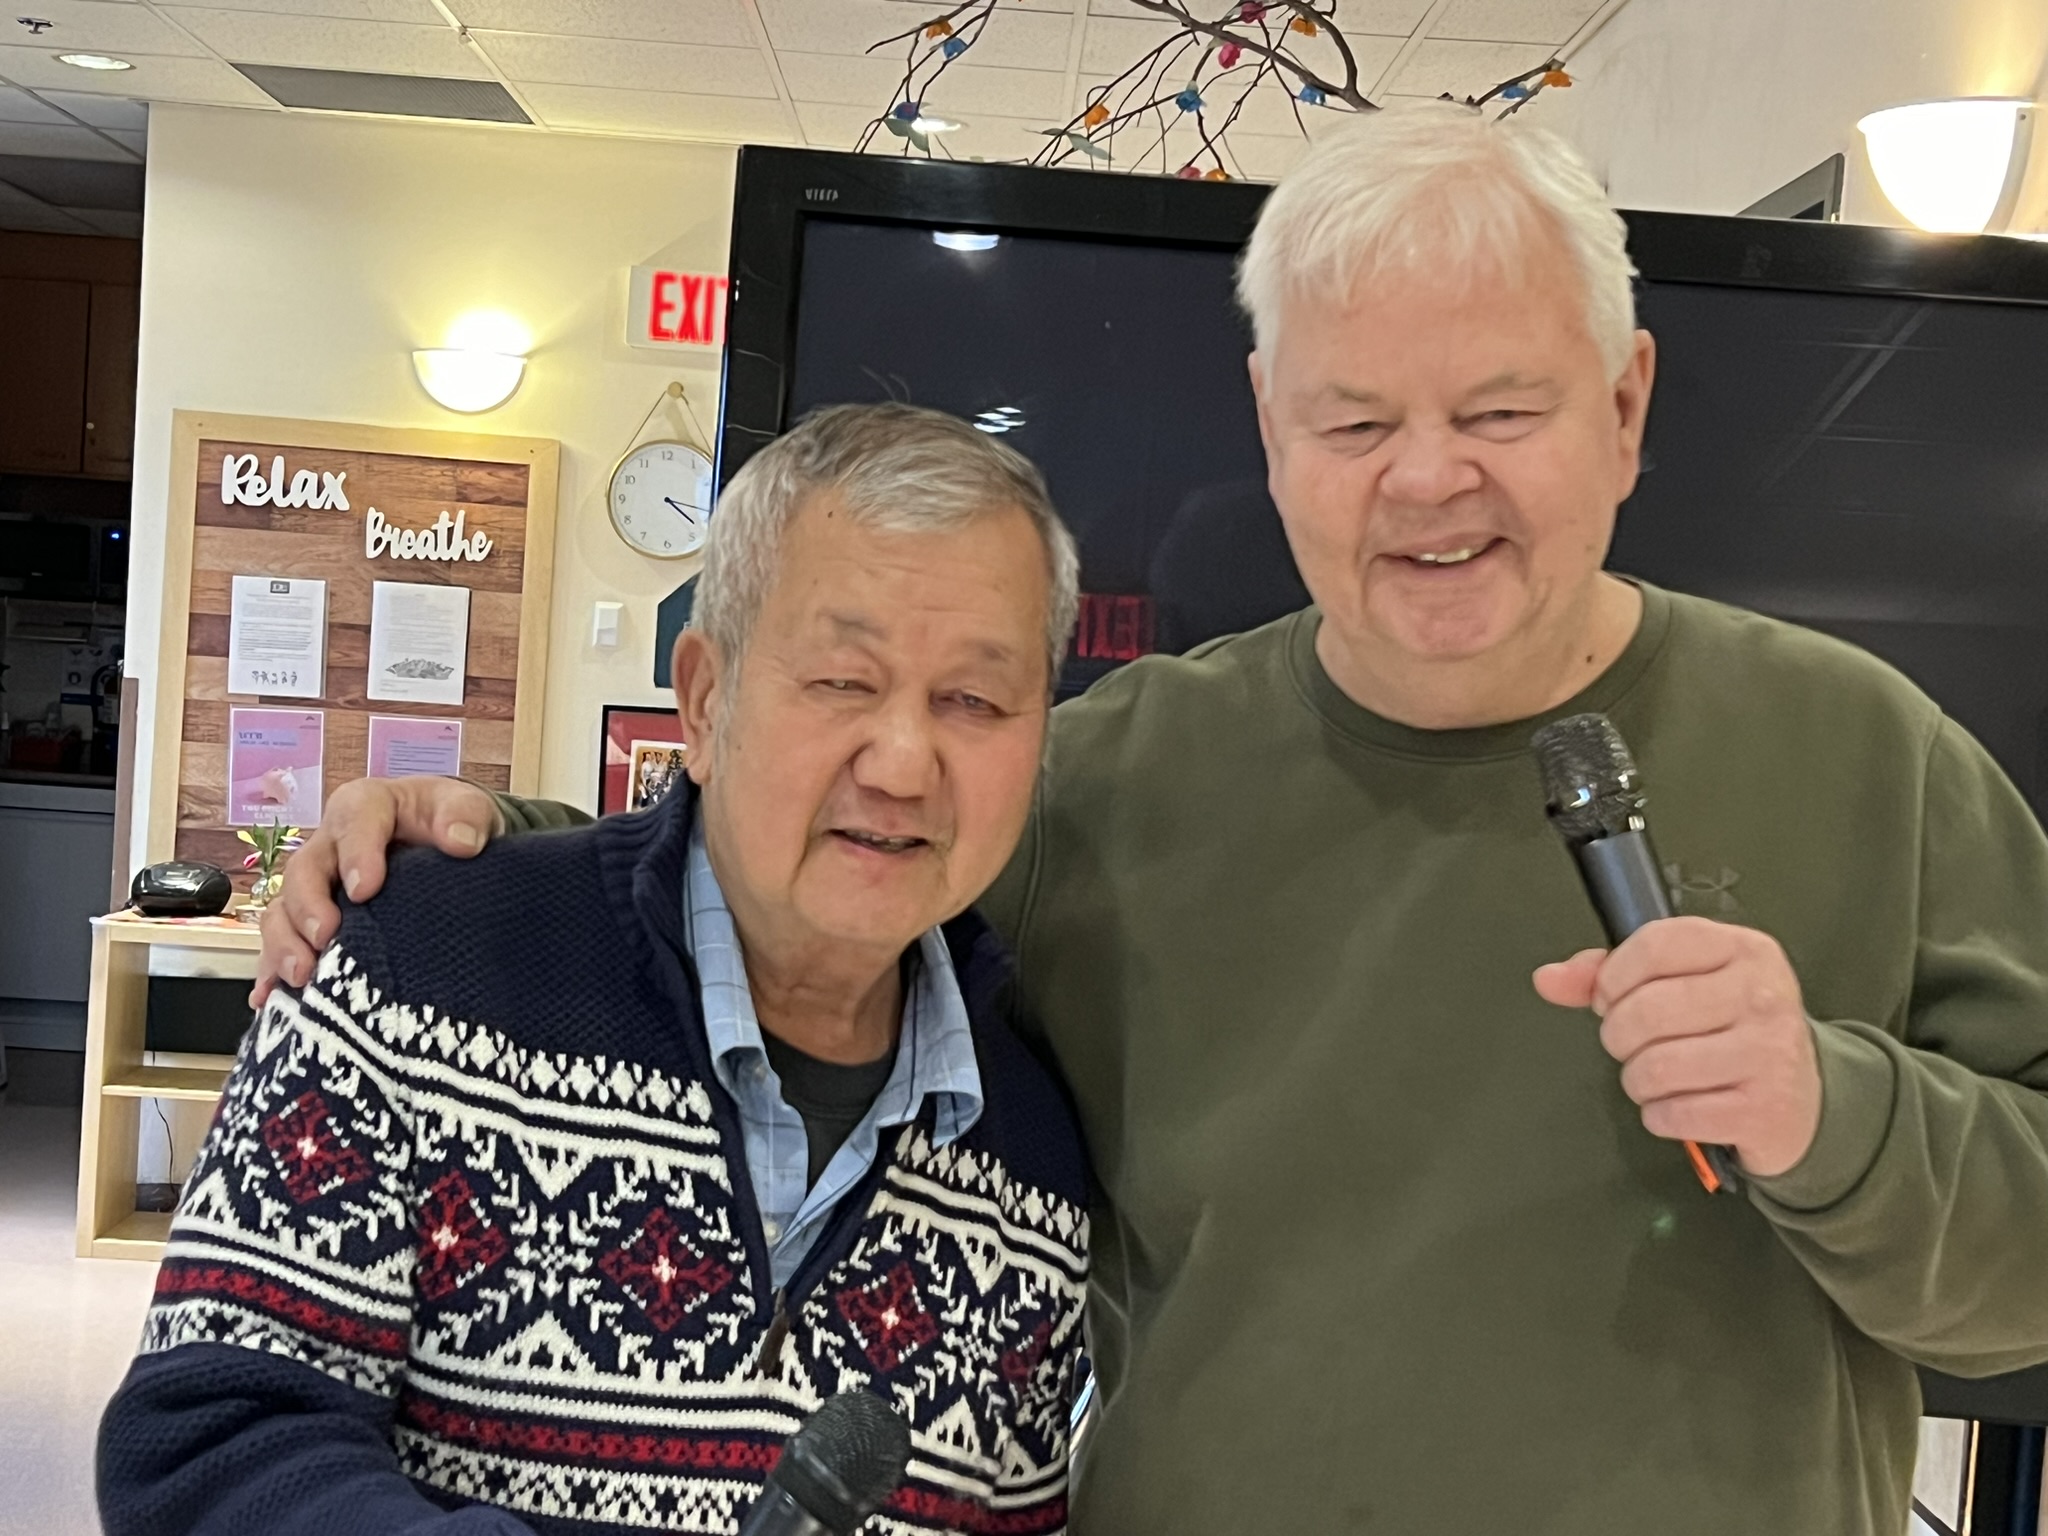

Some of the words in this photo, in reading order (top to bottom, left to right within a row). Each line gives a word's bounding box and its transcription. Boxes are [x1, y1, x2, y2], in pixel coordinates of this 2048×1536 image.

[661, 450, 674, 461] 12
[639, 459, 649, 468] 11
[221, 453, 350, 511] Relax
[625, 475, 636, 485] 10
[618, 493, 626, 504] 9
[624, 515, 632, 525] 8
[365, 507, 493, 562] Breathe
[640, 531, 647, 540] 7
[688, 532, 696, 542] 5
[663, 540, 672, 549] 6
